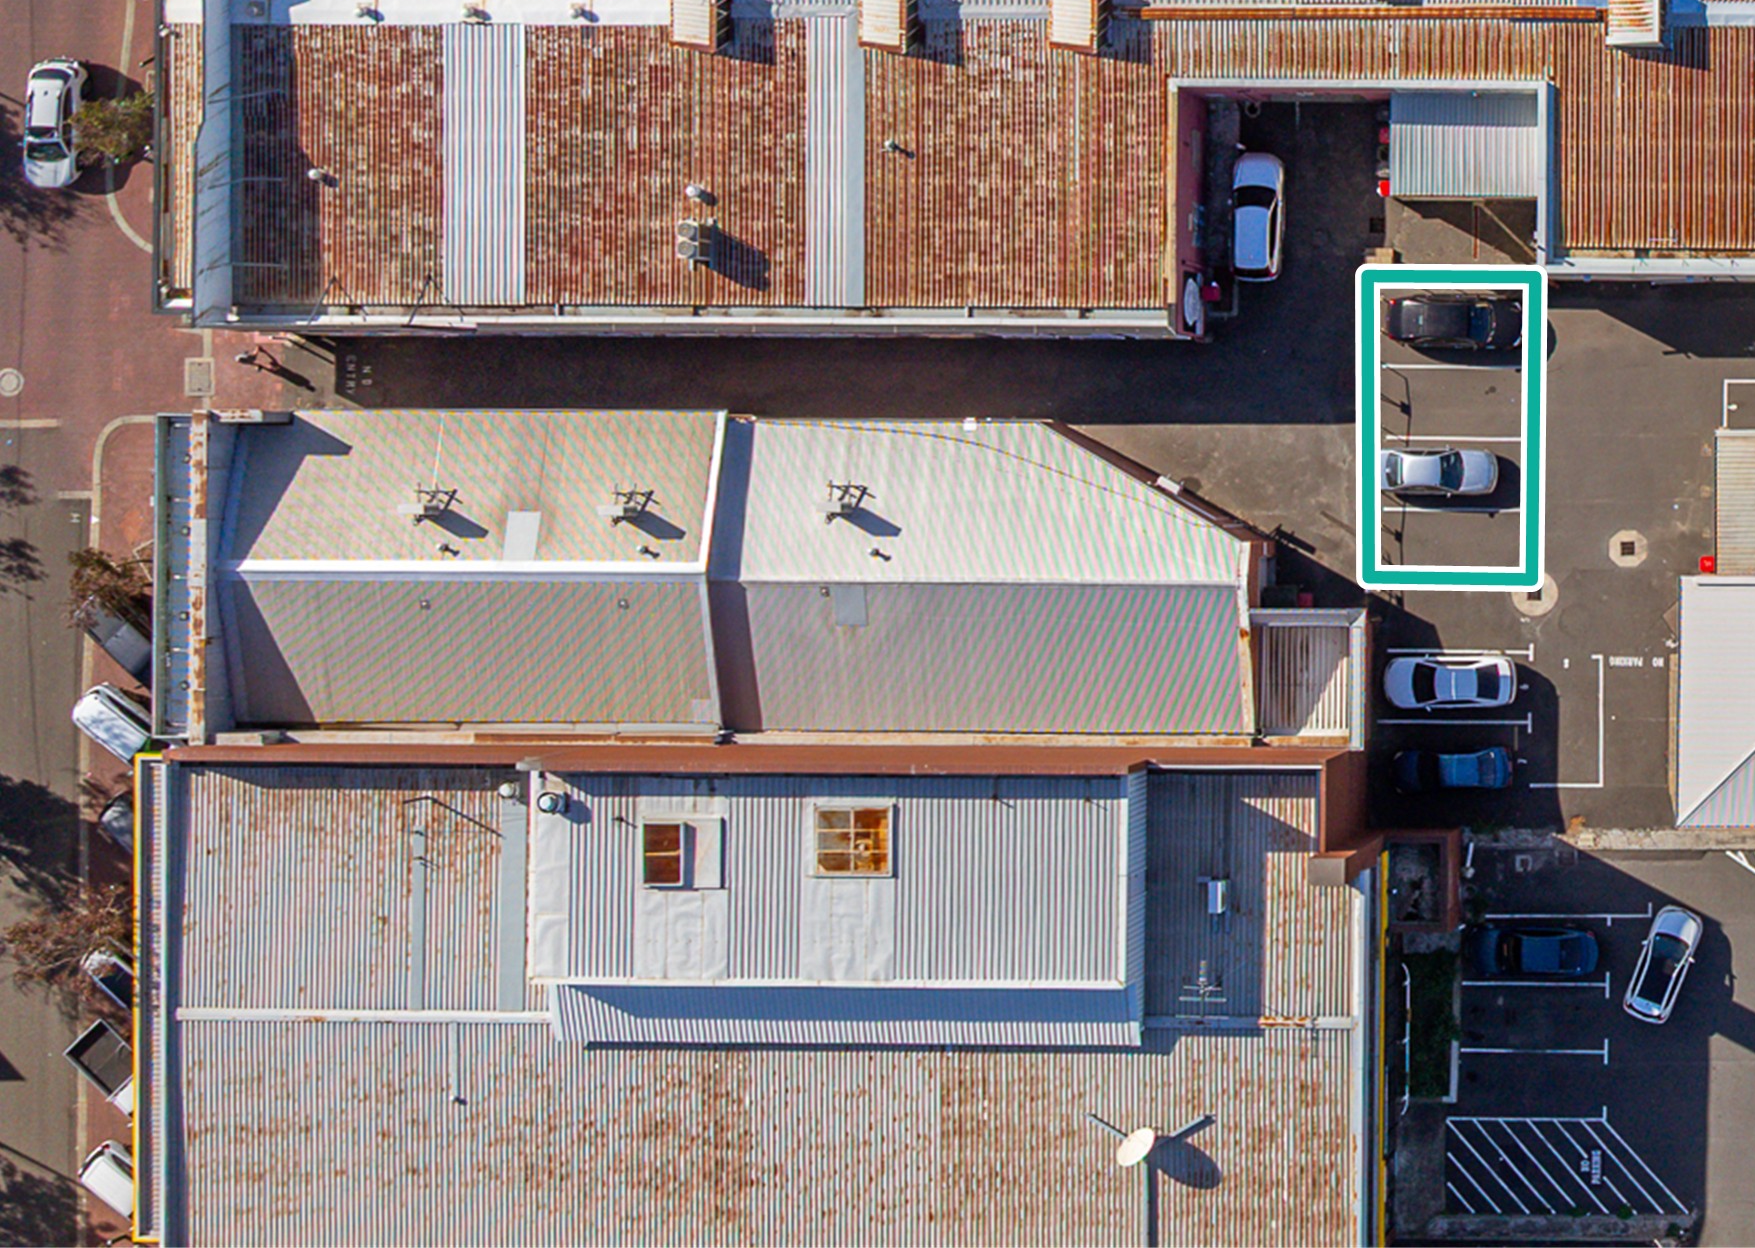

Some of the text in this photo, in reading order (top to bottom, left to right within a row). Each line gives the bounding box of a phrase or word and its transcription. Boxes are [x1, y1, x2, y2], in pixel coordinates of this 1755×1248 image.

[1609, 655, 1664, 667] NO PARKING
[1580, 1160, 1590, 1172] NO
[1591, 1150, 1602, 1185] PARKING
